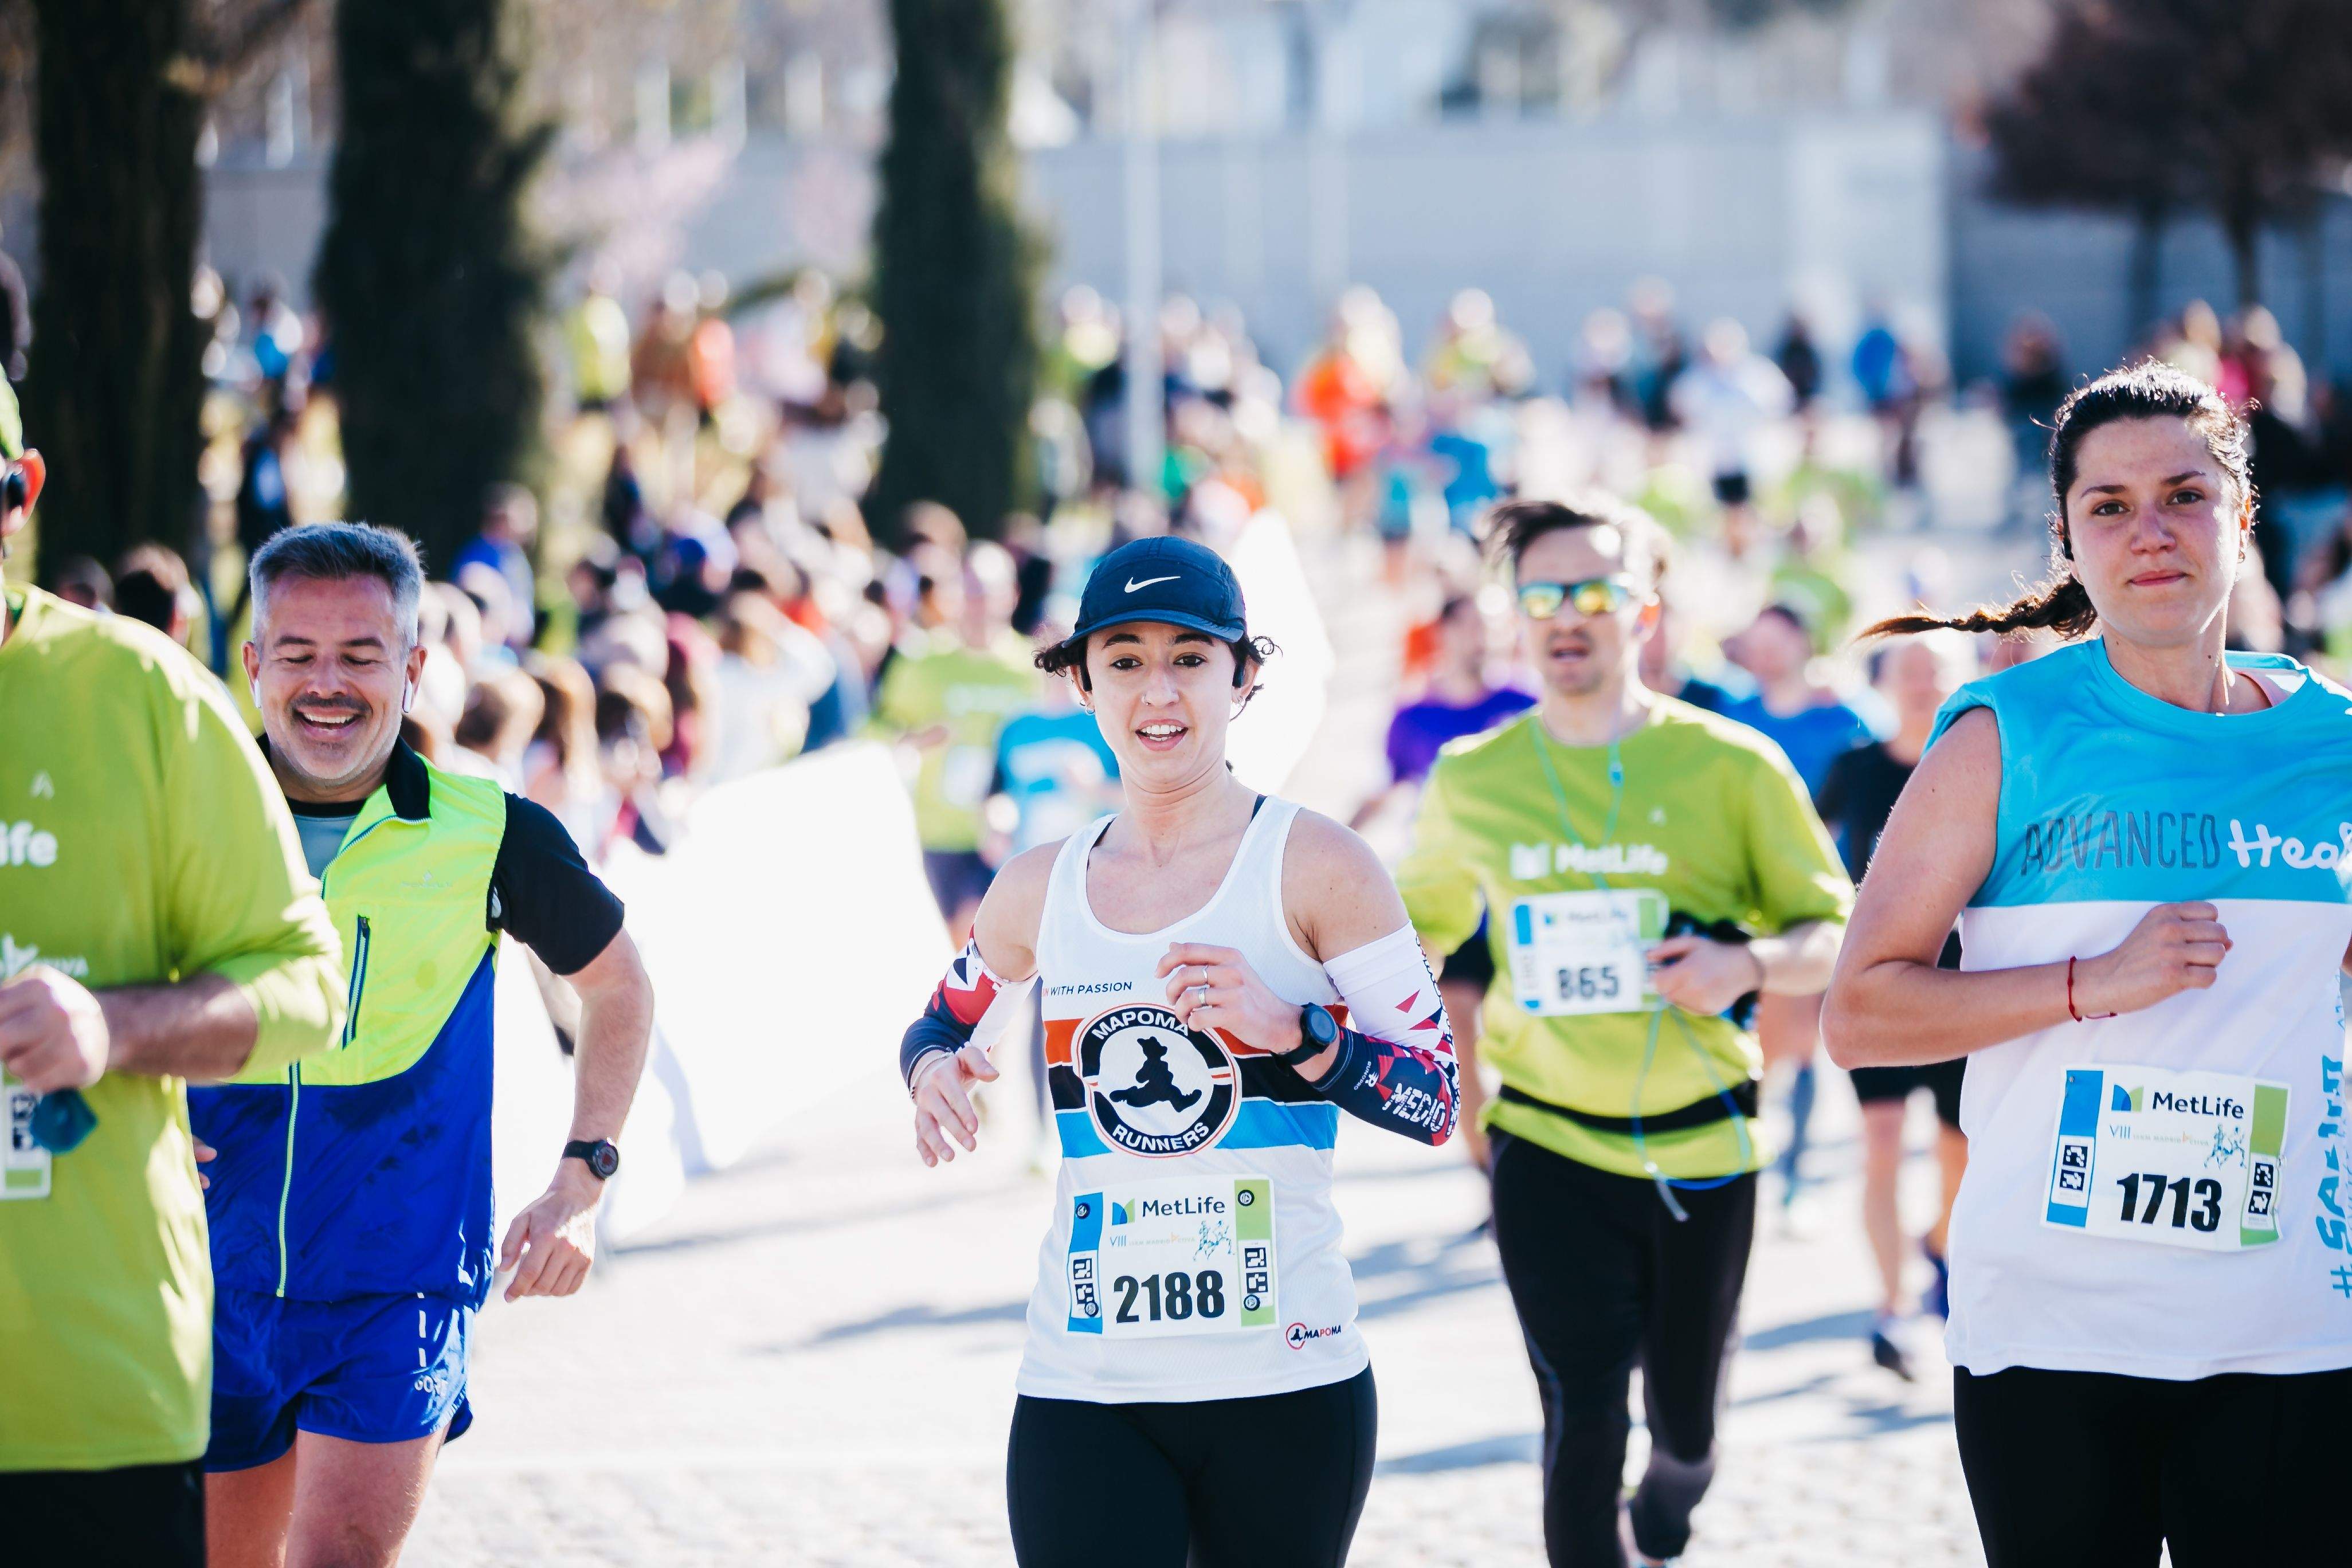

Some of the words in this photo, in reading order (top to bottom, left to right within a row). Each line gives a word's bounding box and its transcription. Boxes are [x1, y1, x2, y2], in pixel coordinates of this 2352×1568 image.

[2020, 810, 2221, 876] ADVANCED
[1050, 985, 1074, 996] WITH
[1077, 981, 1132, 994] PASSION
[1558, 966, 1620, 1000] 865
[1091, 1010, 1189, 1040] MAPOMA
[1382, 1083, 1447, 1132] MEDIO
[2152, 1091, 2245, 1119] MetLife
[1112, 1122, 1210, 1151] RUNNERS
[2110, 1124, 2131, 1139] VIII
[1142, 1195, 1226, 1218] MetLife
[2116, 1172, 2223, 1233] 1713
[1110, 1234, 1127, 1247] VIII
[1113, 1269, 1225, 1324] 2188
[1303, 1324, 1342, 1339] MAPOMA
